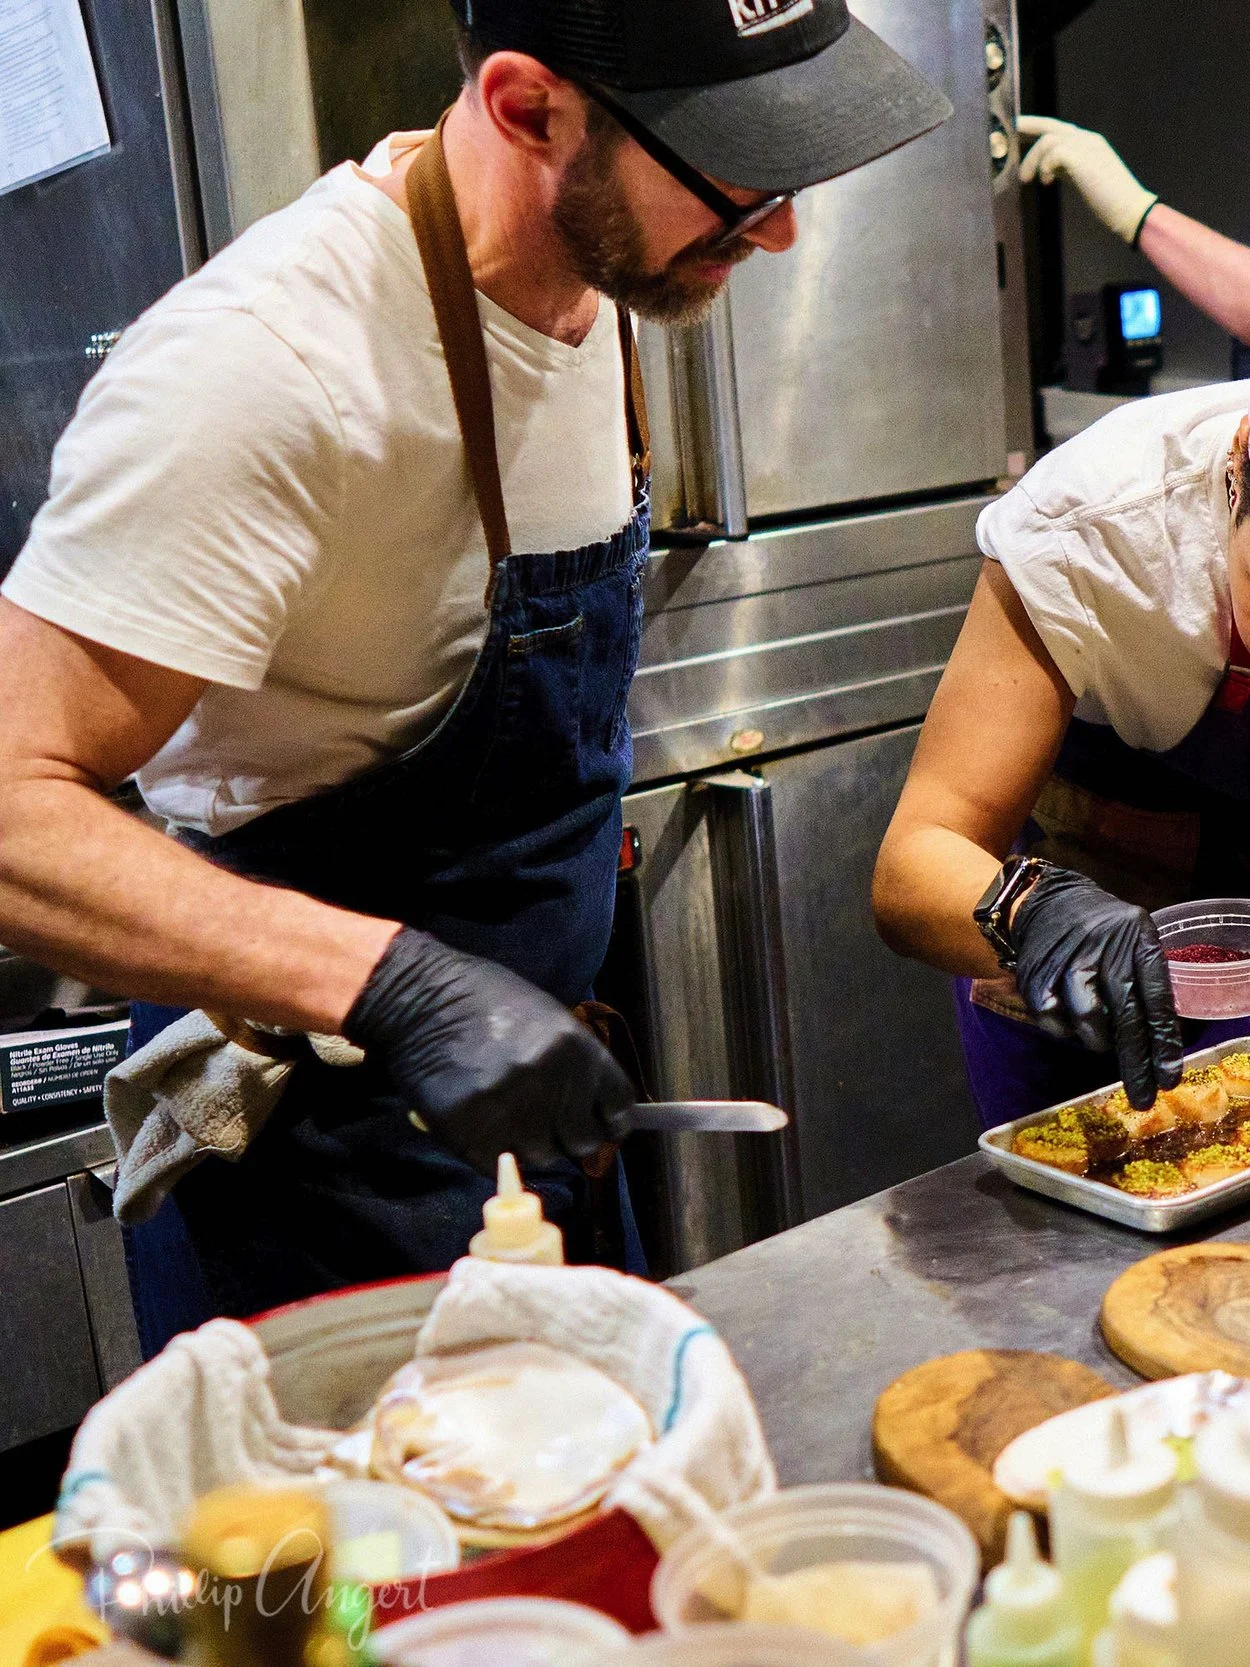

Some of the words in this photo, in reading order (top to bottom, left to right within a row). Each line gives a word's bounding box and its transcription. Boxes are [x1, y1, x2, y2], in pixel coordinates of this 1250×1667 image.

[10, 1049, 33, 1059] Nitrile
[34, 1047, 54, 1055] Exam
[55, 1042, 79, 1051] Gloves
[10, 1055, 41, 1066] Guantes
[42, 1053, 51, 1061] de
[52, 1049, 80, 1059] Examen
[81, 1046, 91, 1054] de
[12, 1095, 37, 1107] QUALITY
[41, 1088, 78, 1101] CONSISTENCY
[82, 1084, 103, 1094] SAFETY
